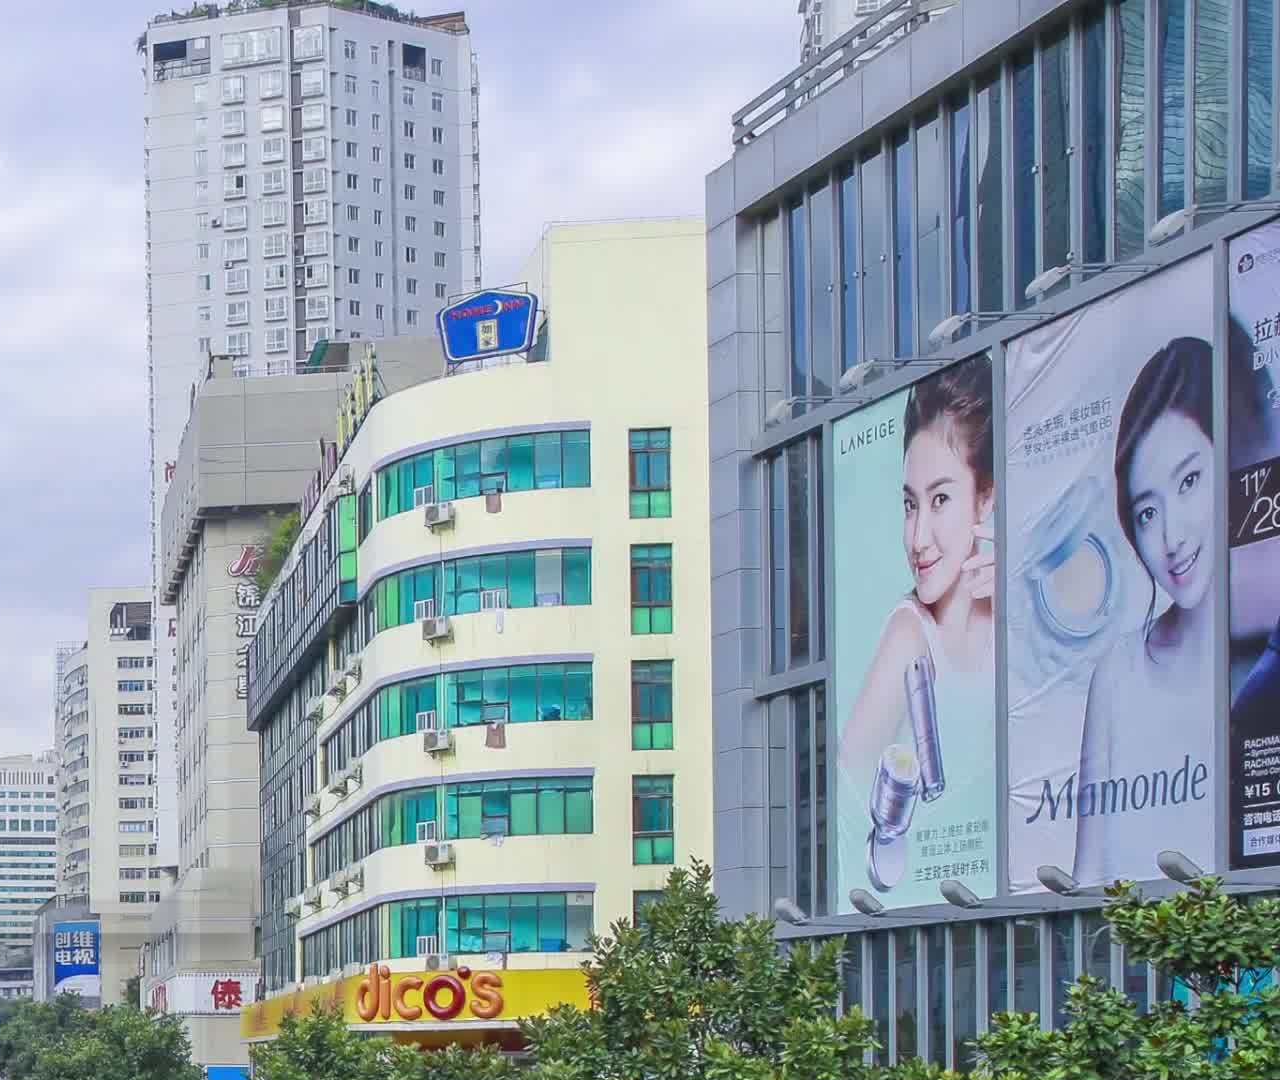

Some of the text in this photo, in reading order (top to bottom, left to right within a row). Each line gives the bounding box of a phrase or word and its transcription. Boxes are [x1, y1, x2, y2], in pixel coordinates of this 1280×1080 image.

[840, 417, 897, 456] LANEIGE
[1026, 754, 1209, 825] Mamonde
[55, 930, 94, 949] 创维
[55, 948, 96, 966] 电视
[355, 962, 505, 1022] dico's
